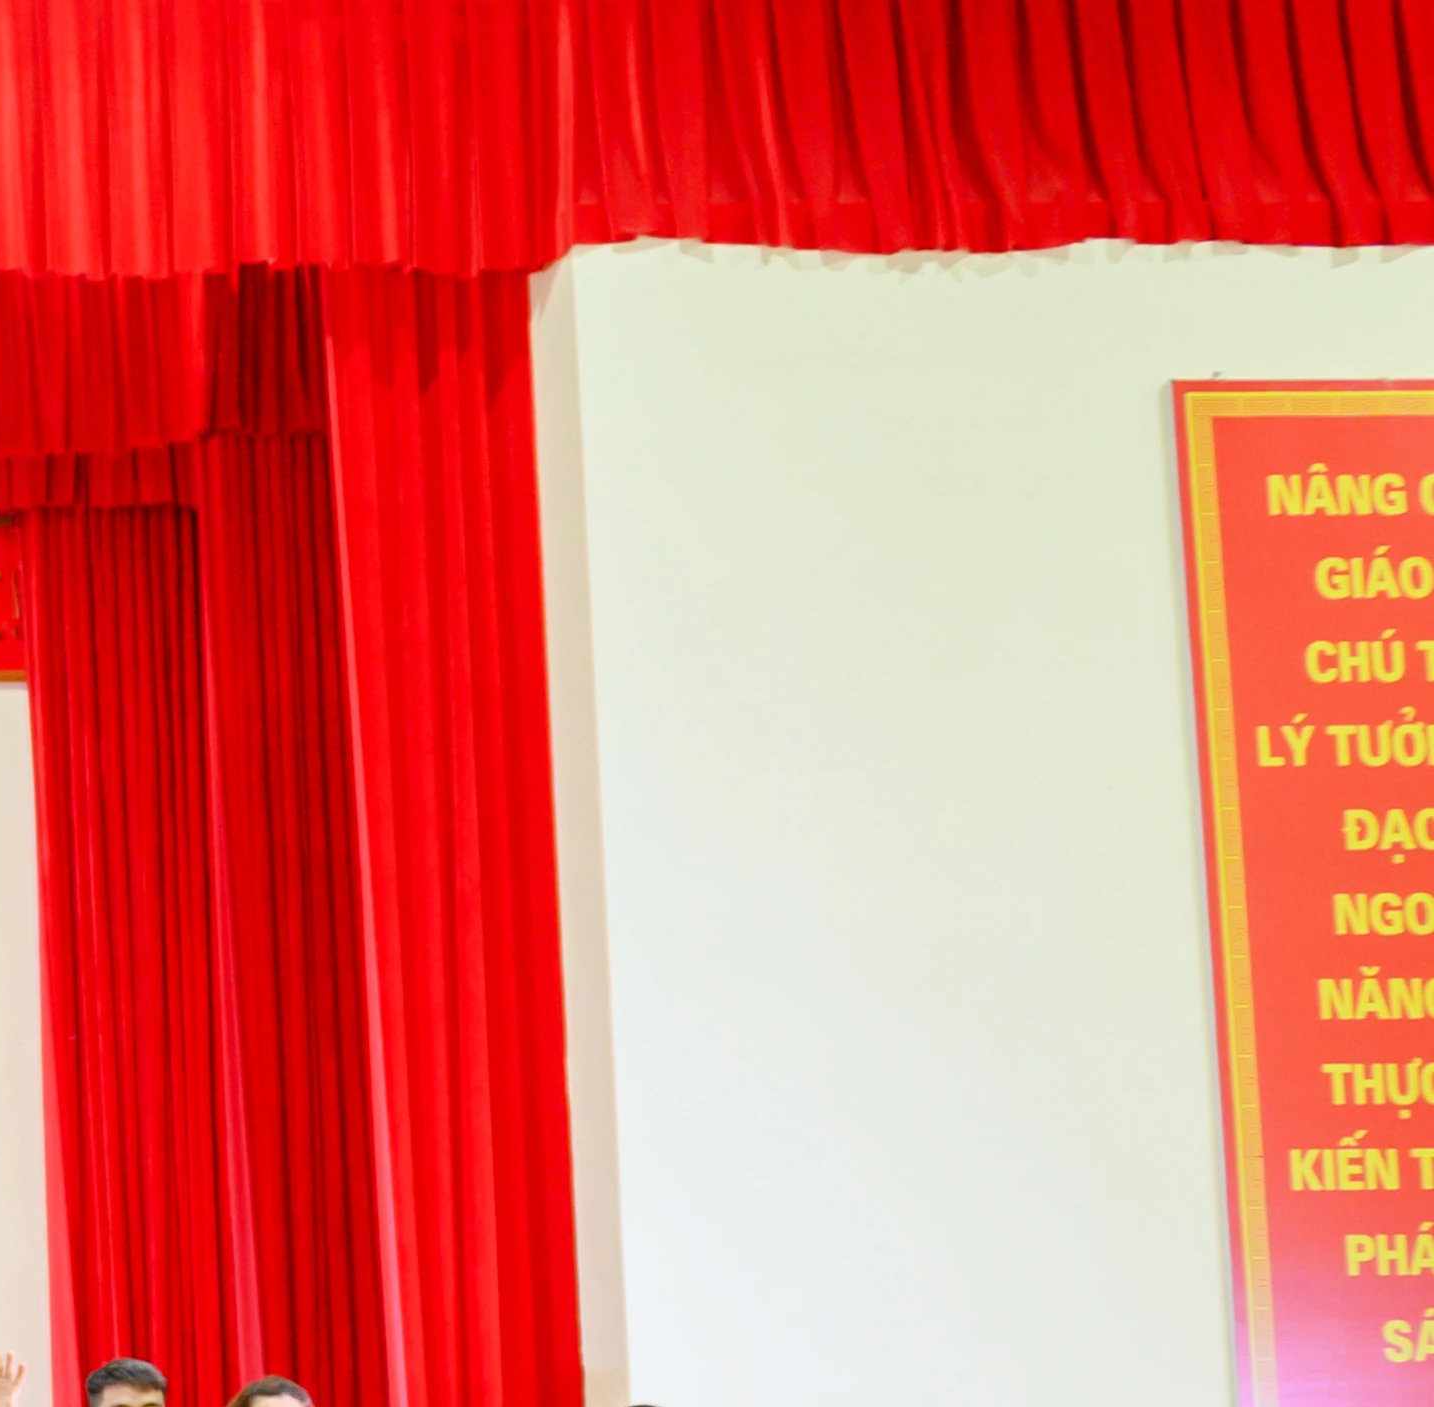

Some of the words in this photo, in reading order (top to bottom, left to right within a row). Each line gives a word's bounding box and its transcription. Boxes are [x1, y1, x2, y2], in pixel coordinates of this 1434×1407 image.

[1268, 463, 1407, 515] NÂNG
[1316, 546, 1434, 599] GIÁO
[1306, 629, 1405, 683] CHÚ
[1258, 714, 1314, 766] LÝ
[1326, 707, 1434, 766] TƯỞ
[1290, 1130, 1399, 1190] KIẾN
